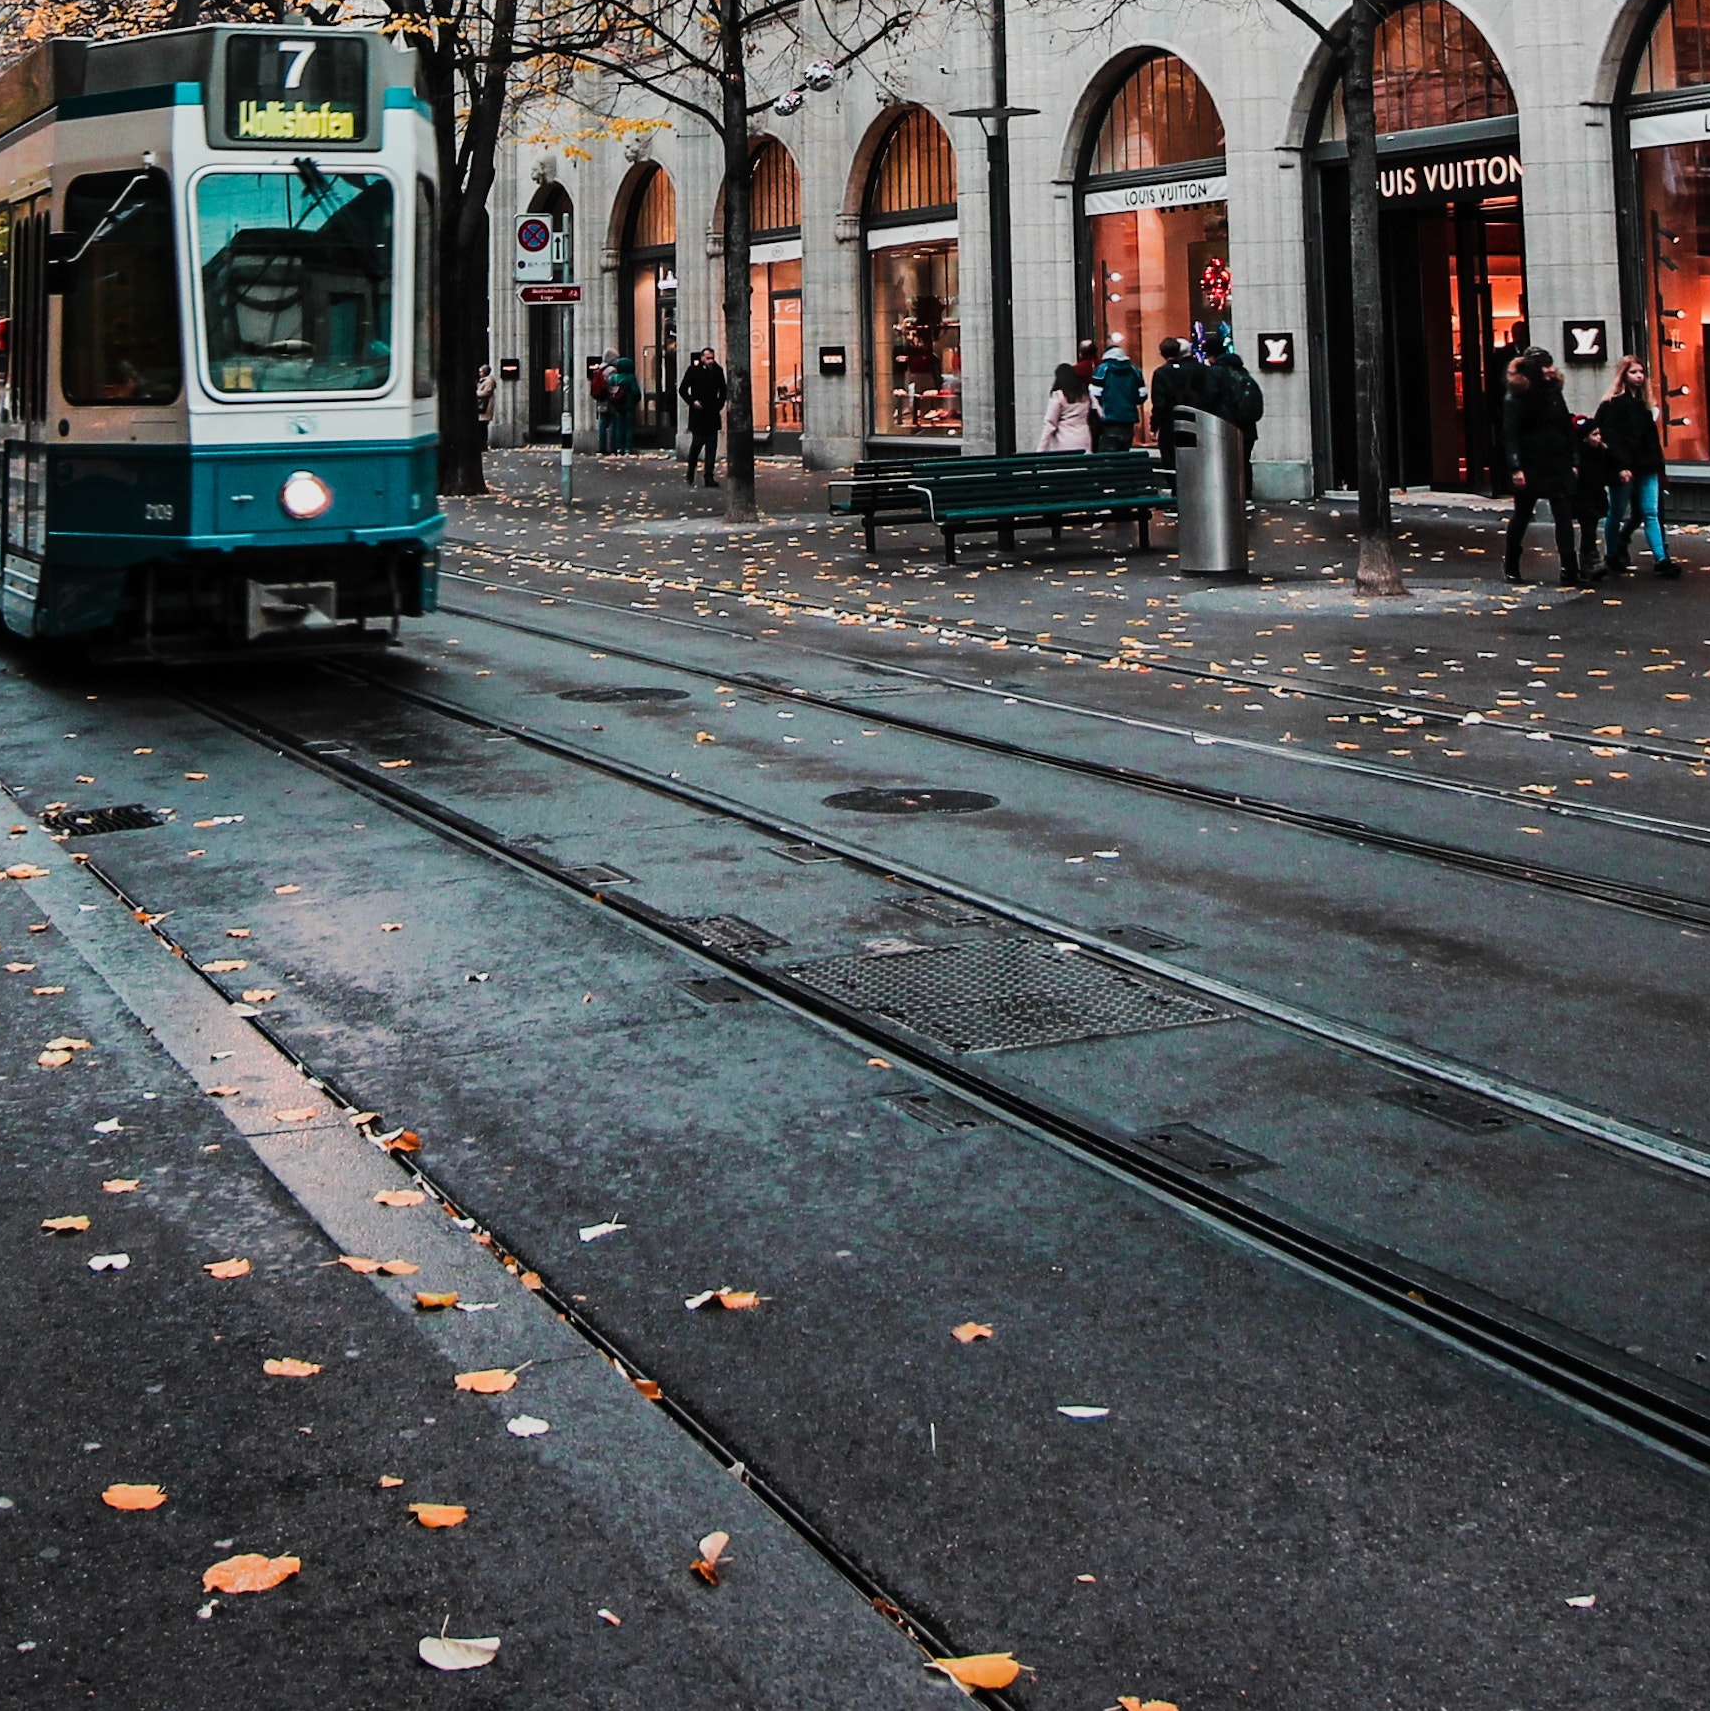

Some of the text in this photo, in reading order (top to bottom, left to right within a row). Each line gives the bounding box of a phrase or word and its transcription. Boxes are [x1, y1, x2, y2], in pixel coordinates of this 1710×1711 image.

[278, 40, 317, 88] 7
[1125, 182, 1207, 206] LOUIS VUITTON
[1376, 154, 1525, 198] UIS VUITTON
